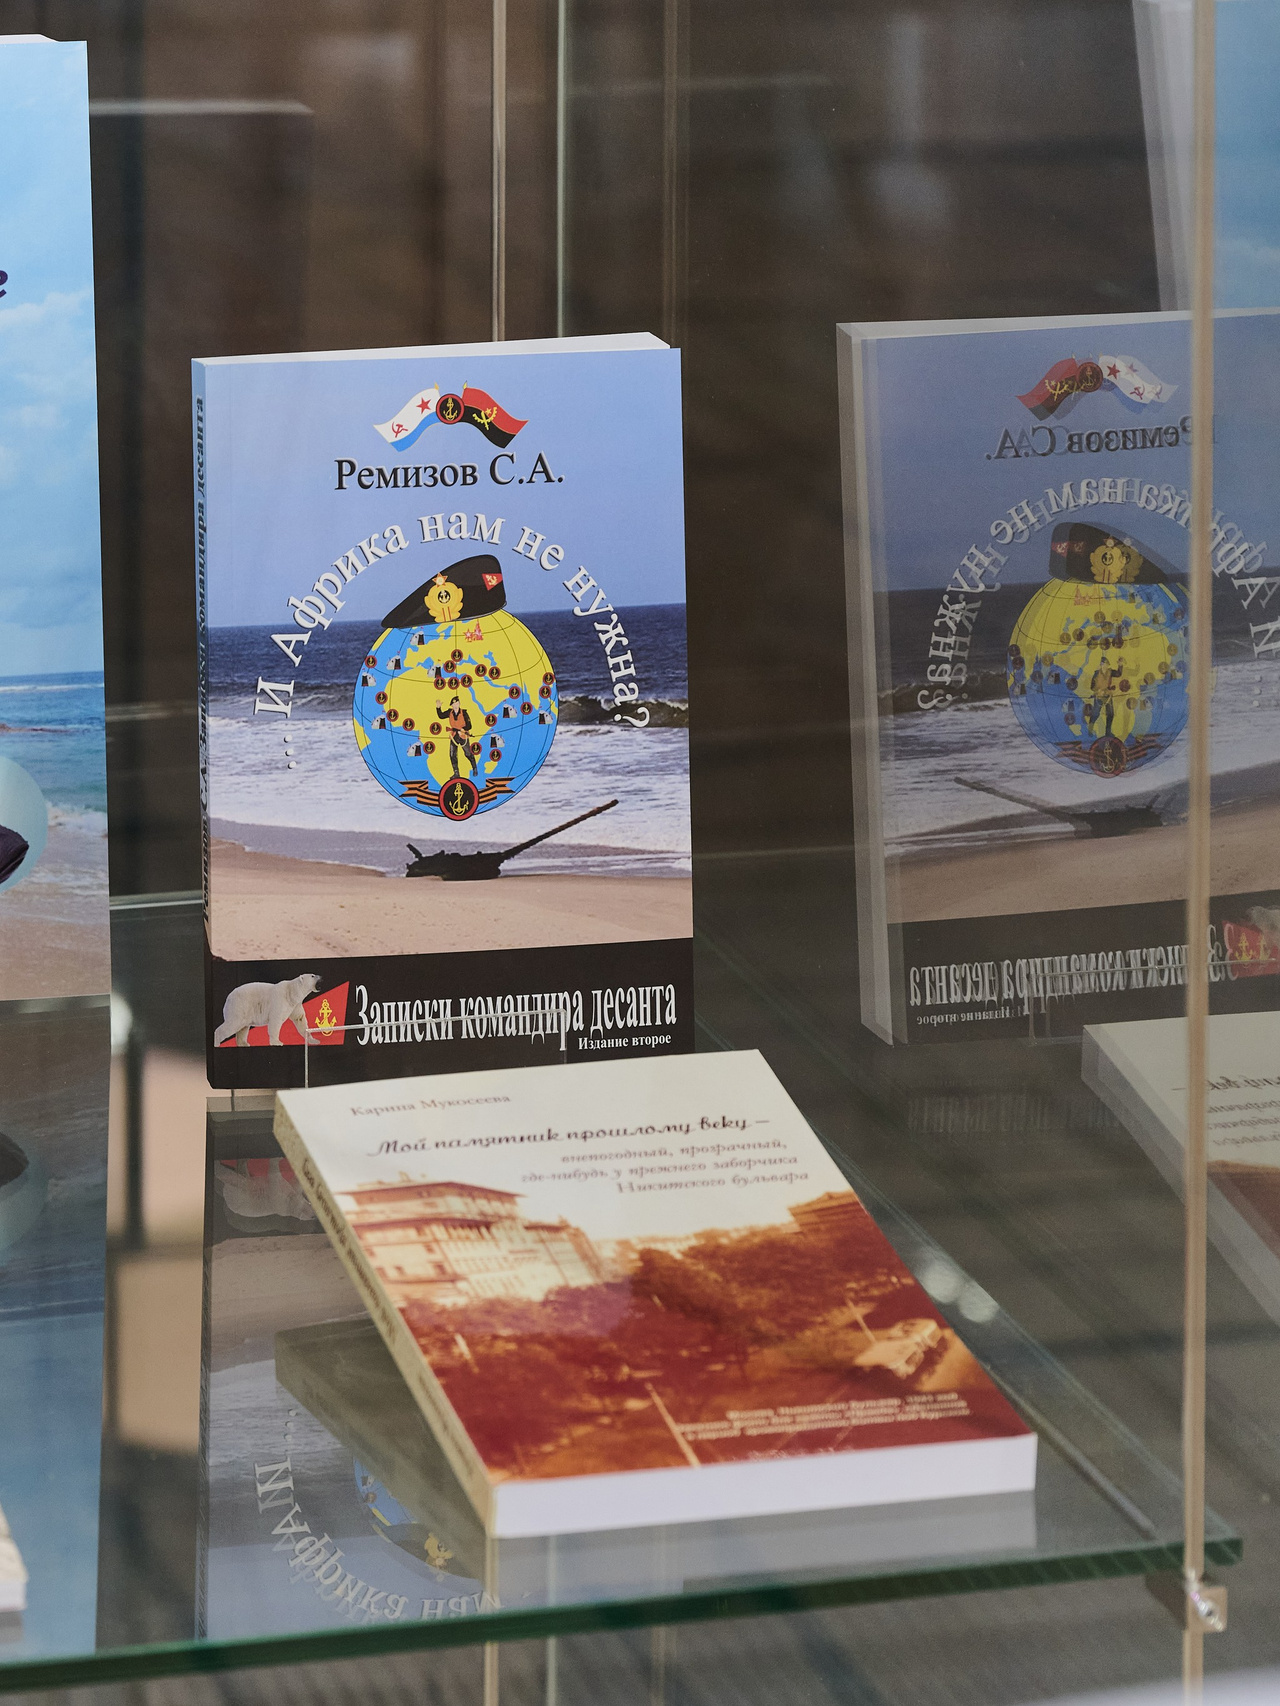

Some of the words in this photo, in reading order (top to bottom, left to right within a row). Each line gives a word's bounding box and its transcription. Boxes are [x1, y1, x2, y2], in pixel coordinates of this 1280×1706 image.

[334, 457, 479, 491] Ремизов
[489, 451, 565, 485] С.А.
[271, 522, 410, 666] Африка
[418, 511, 506, 544] нам
[513, 525, 566, 571] не
[563, 566, 651, 729] нужна?
[355, 984, 453, 1046] Записки
[459, 989, 584, 1051] командира
[590, 982, 677, 1039] десанта
[577, 1035, 629, 1051] Издание
[631, 1031, 672, 1048] второе
[368, 1137, 428, 1157] Мой
[434, 1127, 560, 1149] памятник
[567, 1121, 694, 1143] прошлому
[698, 1114, 750, 1132] веку
[680, 1138, 788, 1157] прозрачный,
